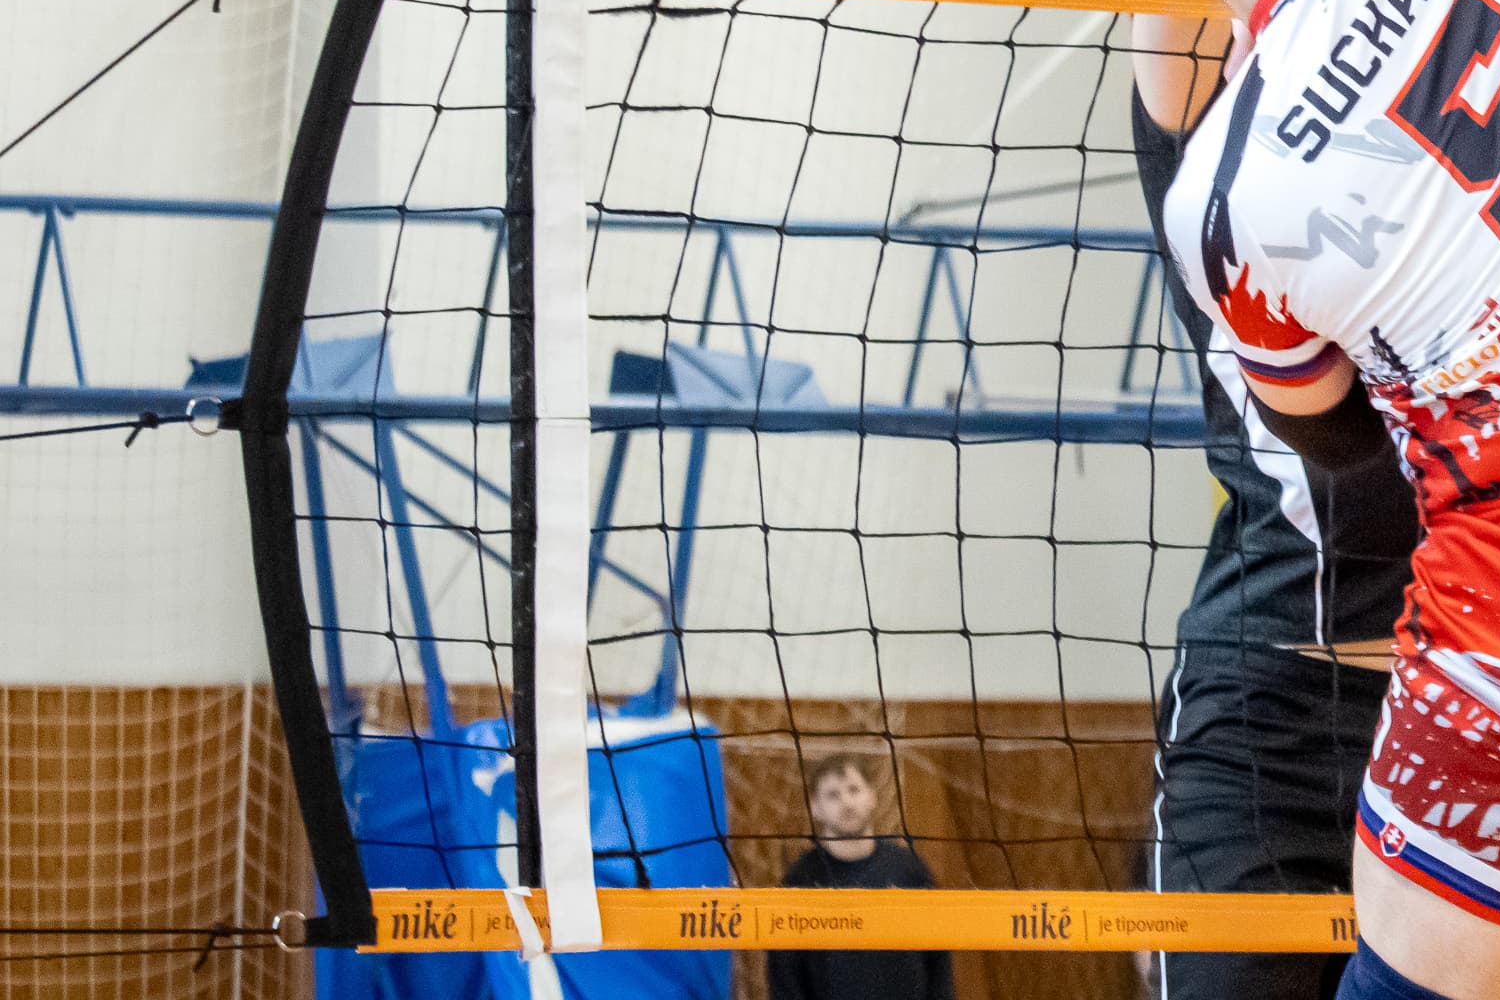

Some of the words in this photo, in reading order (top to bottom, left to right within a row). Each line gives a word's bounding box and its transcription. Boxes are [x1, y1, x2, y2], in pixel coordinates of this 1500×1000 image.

[392, 899, 457, 939] niké
[484, 917, 501, 934] je
[680, 900, 742, 938] niké
[769, 913, 784, 934] je
[788, 913, 863, 934] tipovanie
[1012, 902, 1071, 939] niké
[1099, 916, 1112, 936] je
[1115, 916, 1189, 935] tipovanie
[1331, 907, 1357, 941] ni
